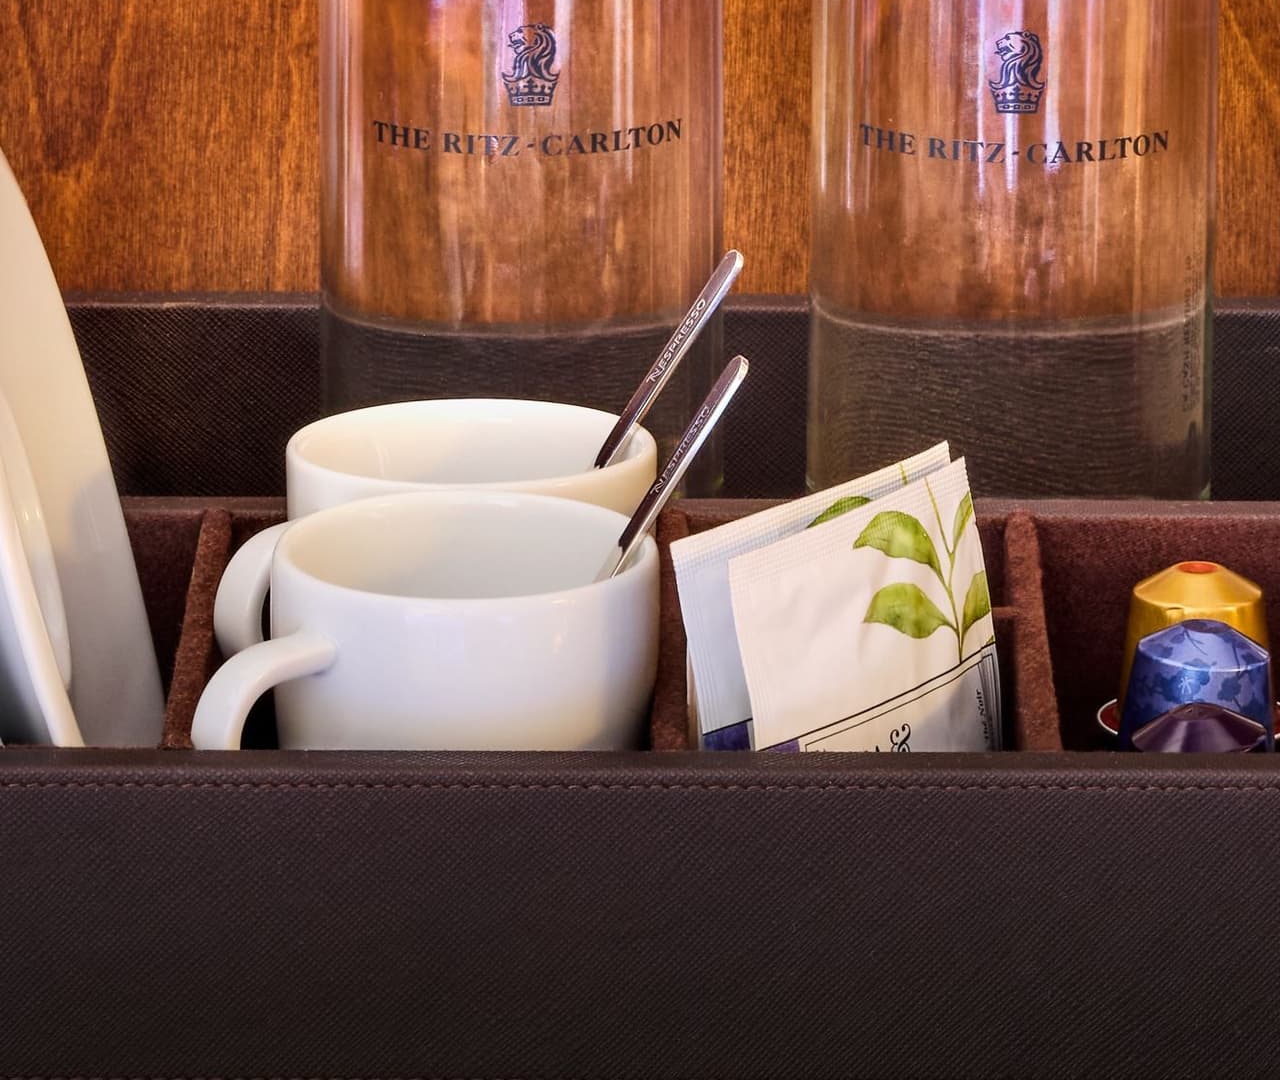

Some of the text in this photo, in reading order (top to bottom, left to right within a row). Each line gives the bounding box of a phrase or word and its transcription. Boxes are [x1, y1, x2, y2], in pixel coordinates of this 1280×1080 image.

[373, 120, 431, 150] THE
[860, 123, 916, 155] THE
[646, 298, 706, 383] NESPRESSO
[650, 406, 710, 494] NESPRESSO
